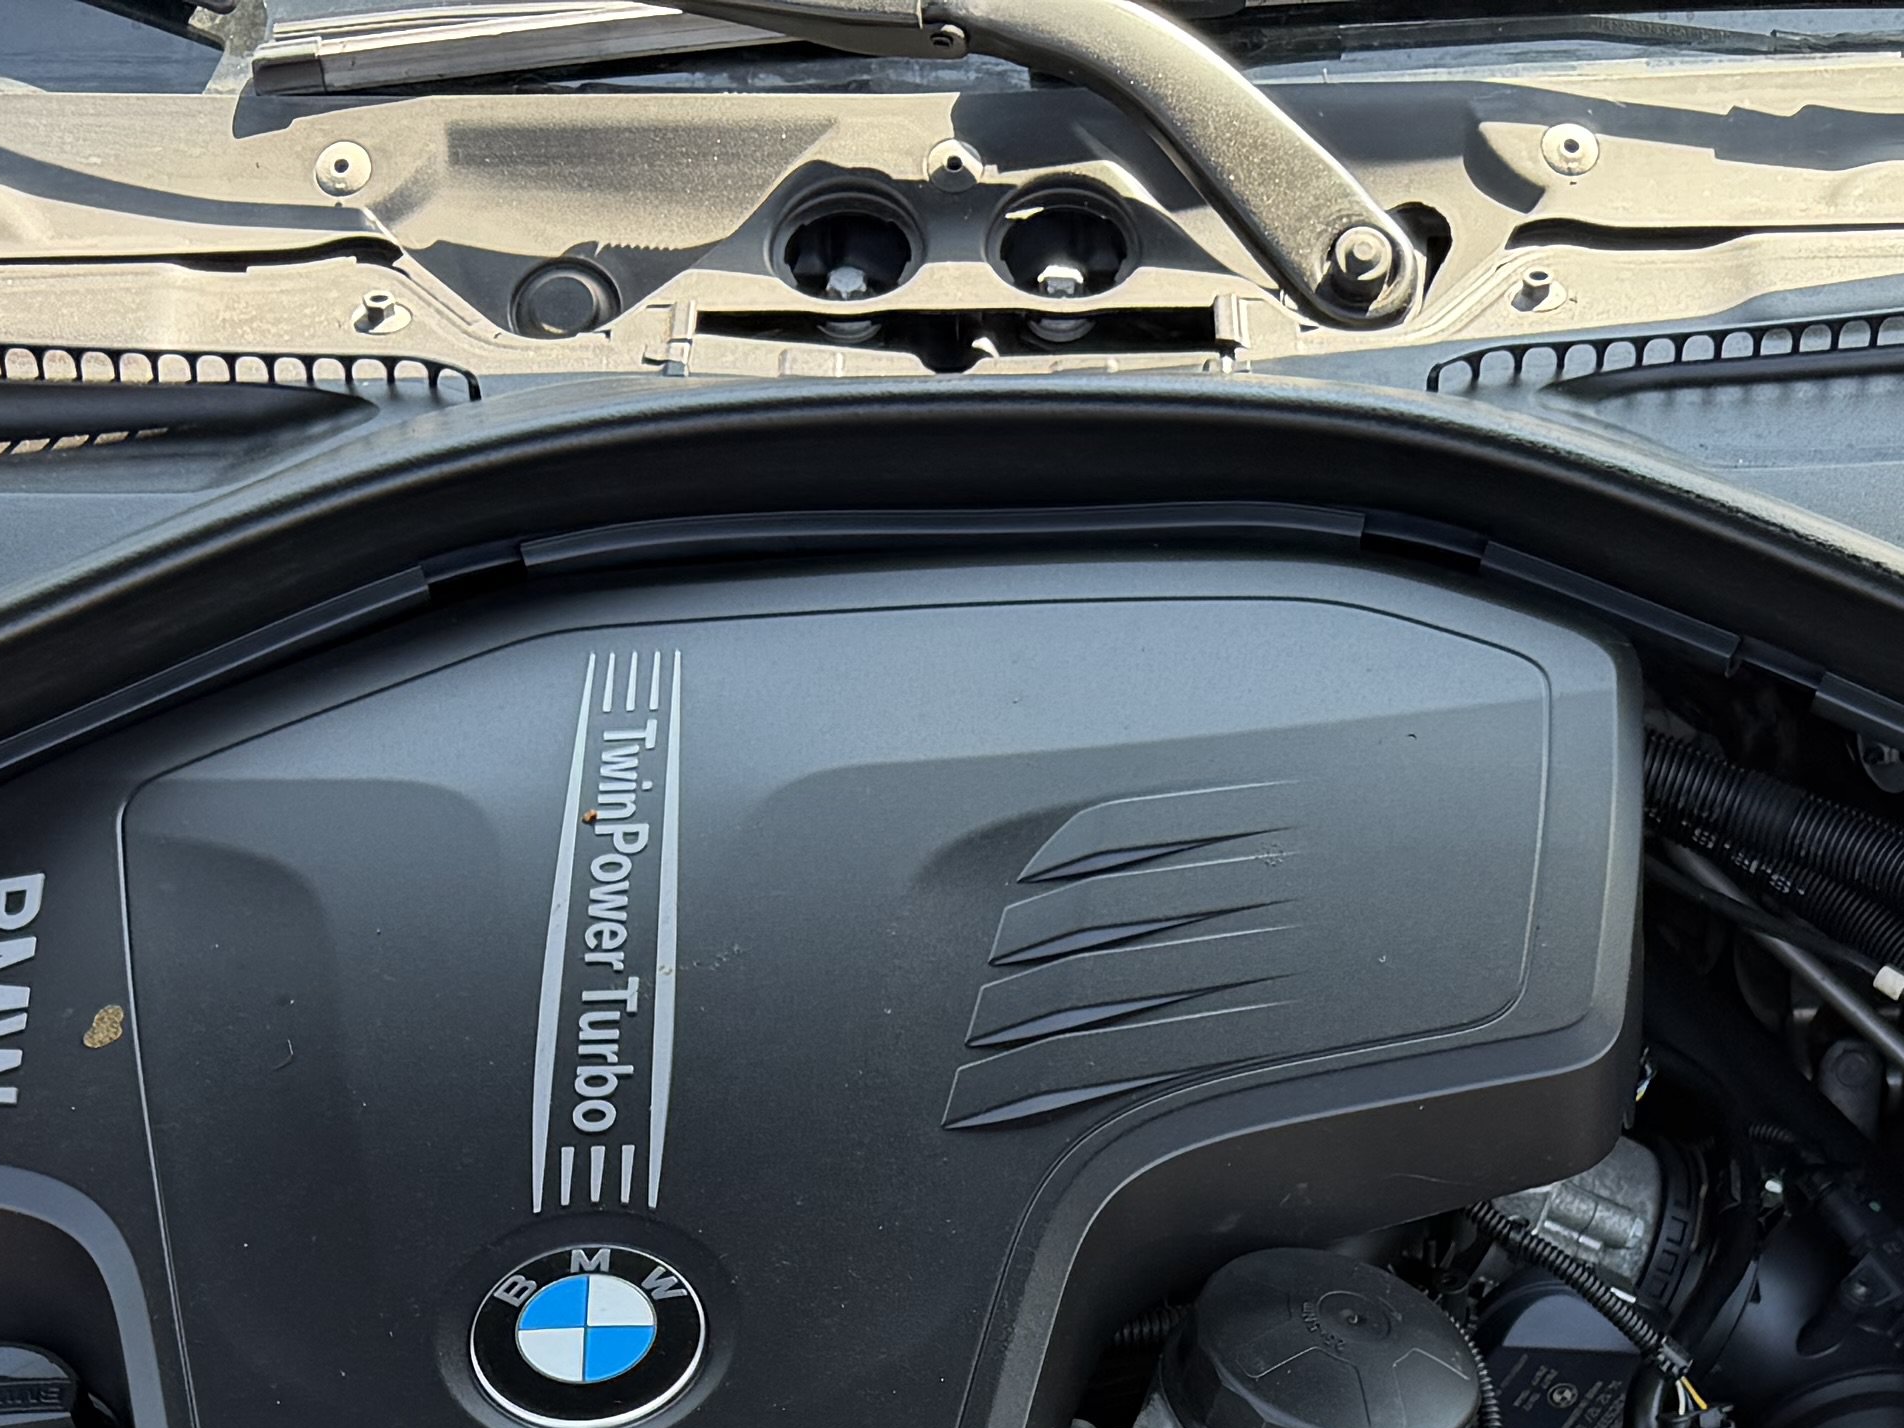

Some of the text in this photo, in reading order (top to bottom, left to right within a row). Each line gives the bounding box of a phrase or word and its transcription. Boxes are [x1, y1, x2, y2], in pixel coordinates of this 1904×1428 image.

[572, 719, 657, 1133] TwinPower Turbo
[493, 1248, 688, 1308] BMW
